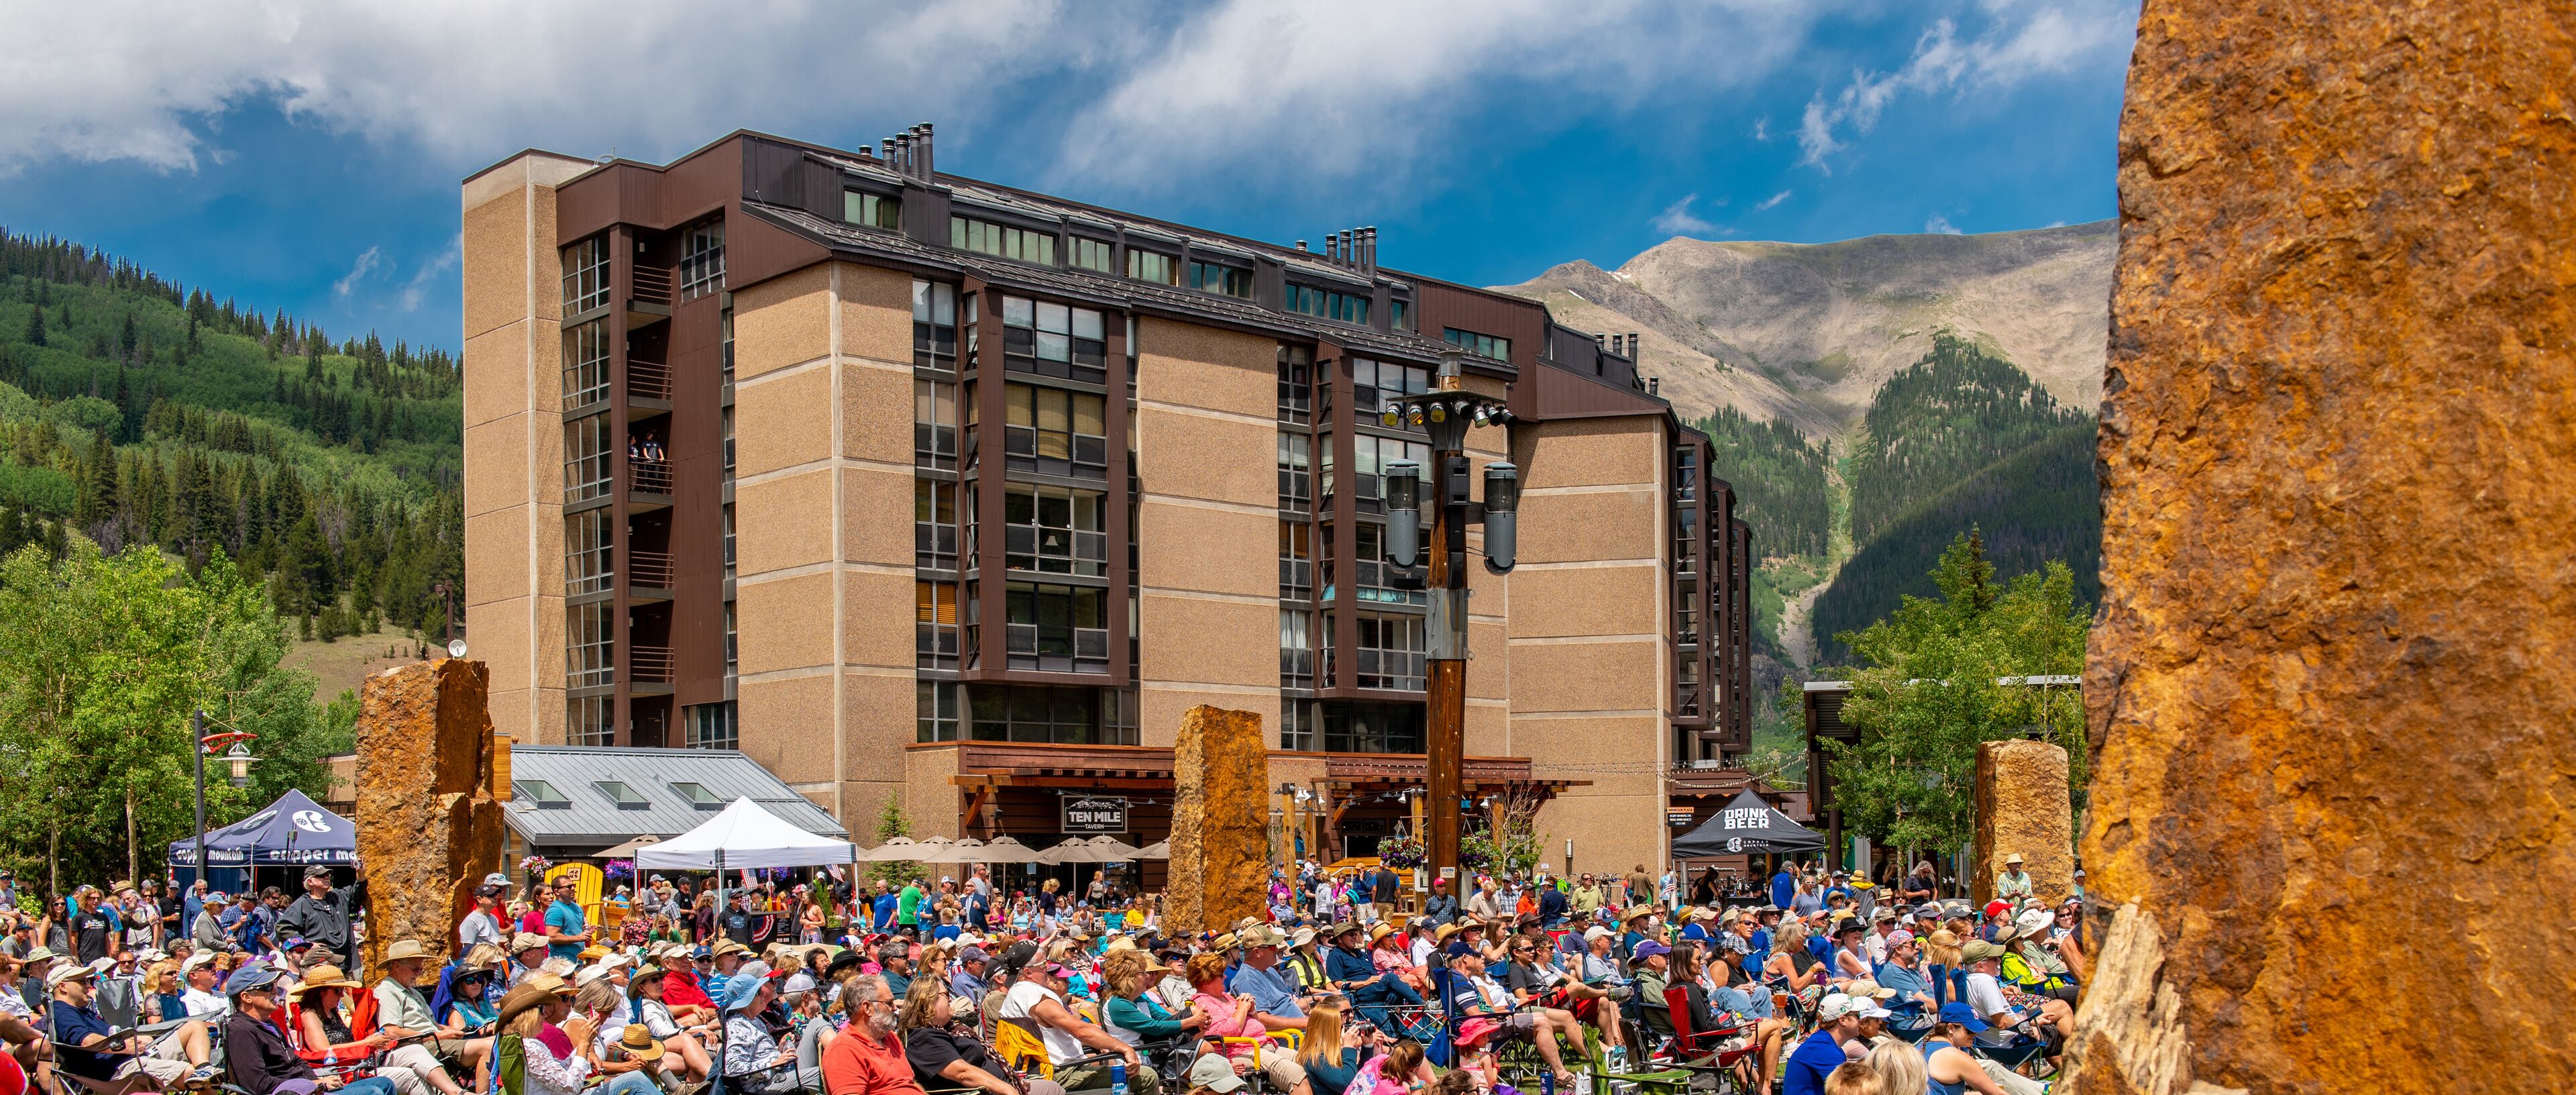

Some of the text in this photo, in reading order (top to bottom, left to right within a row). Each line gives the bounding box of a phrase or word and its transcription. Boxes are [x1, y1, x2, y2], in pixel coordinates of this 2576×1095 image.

[1069, 812, 1121, 822] TEN MILE
[1724, 807, 1769, 819] DRINK
[1724, 817, 1770, 829] BEER
[209, 847, 244, 861] mountain
[270, 849, 329, 864] copper
